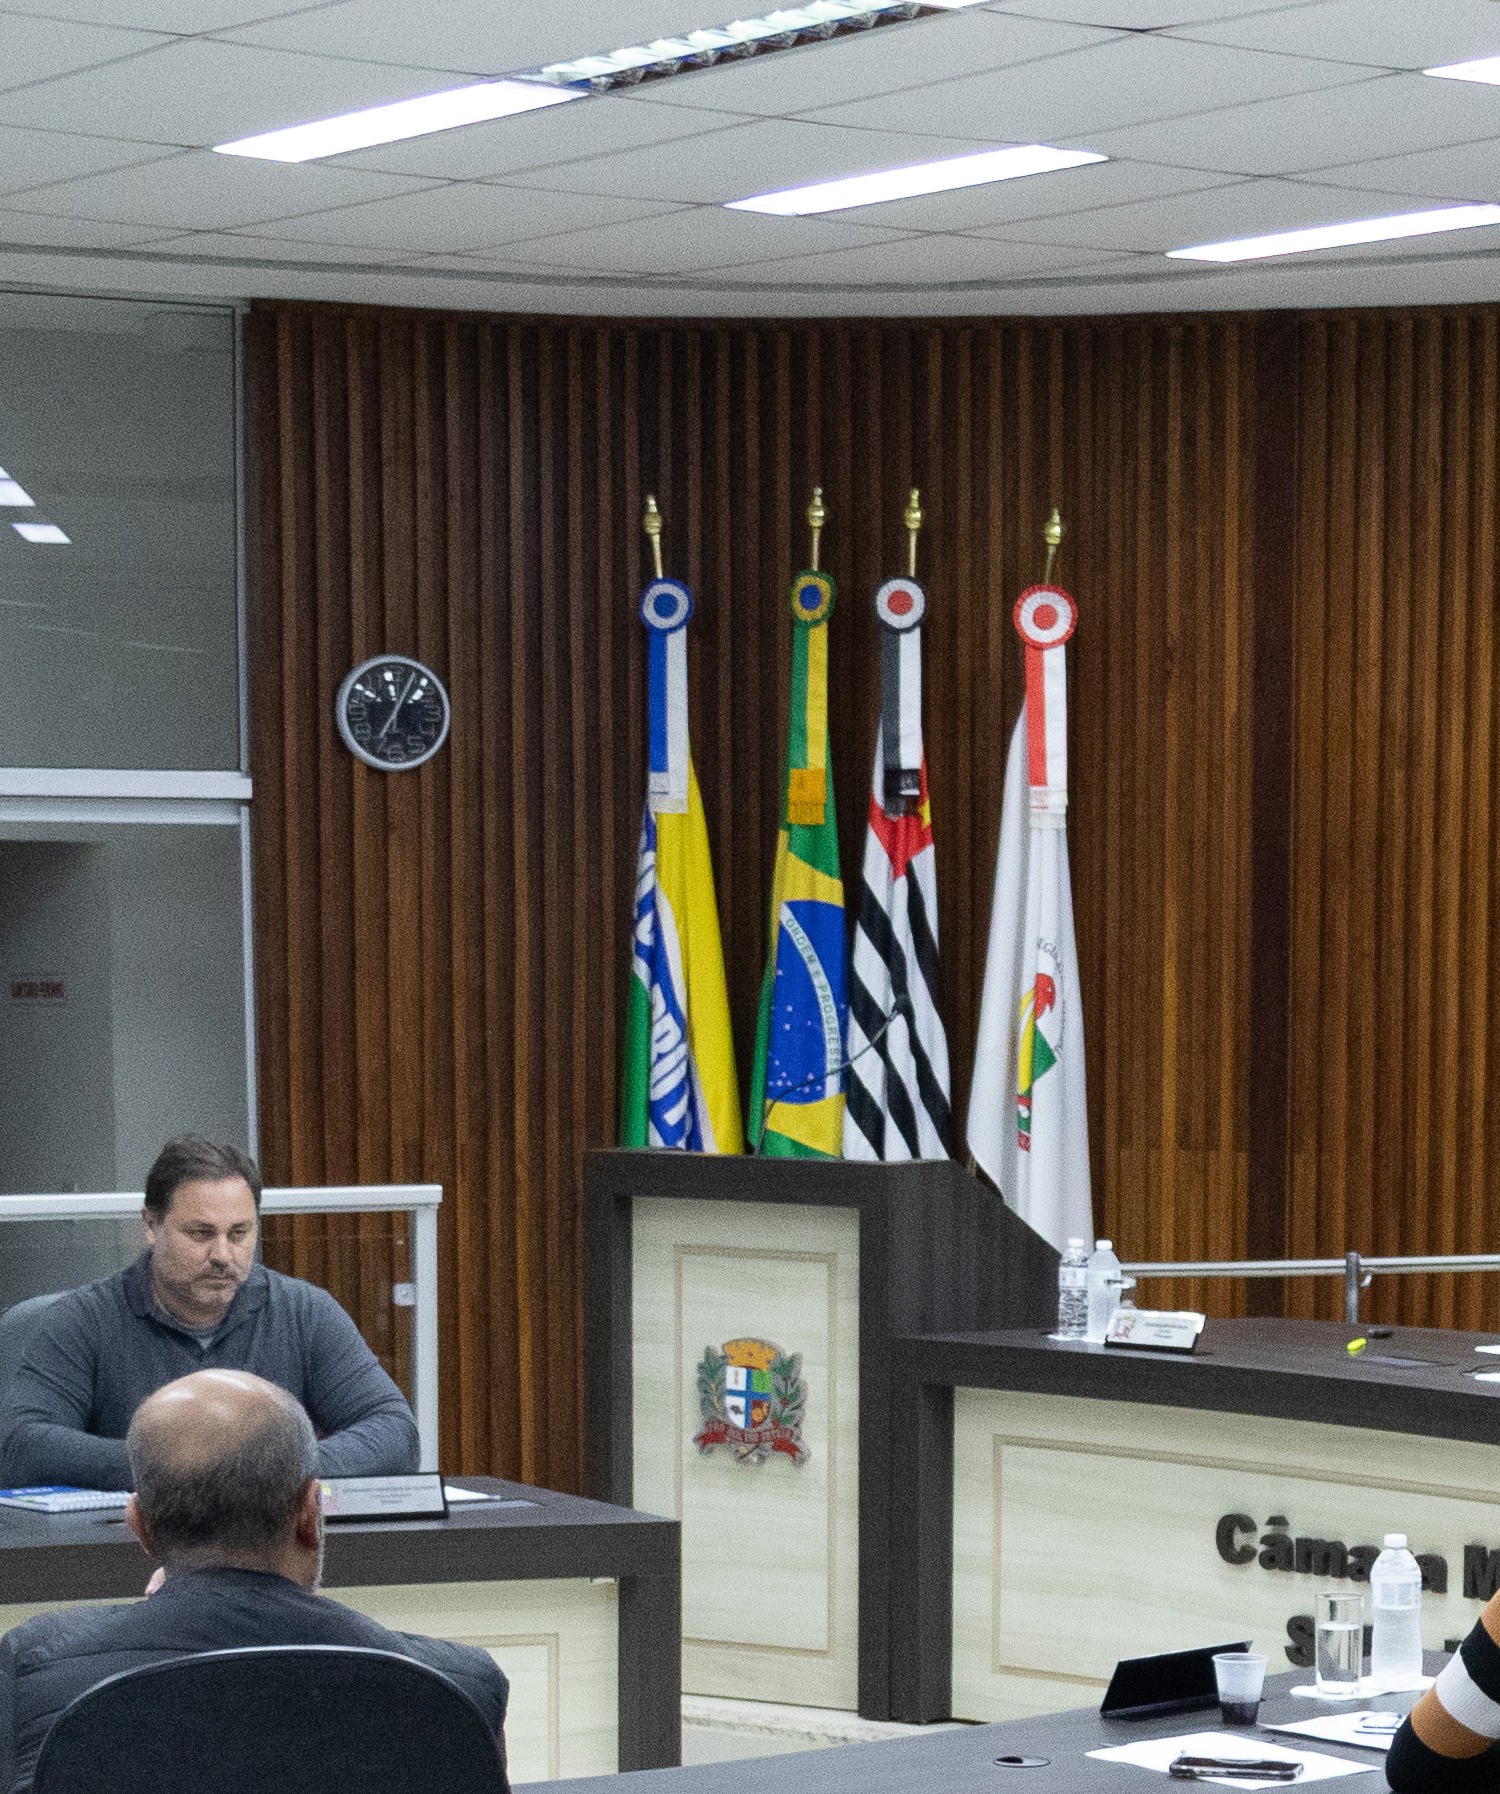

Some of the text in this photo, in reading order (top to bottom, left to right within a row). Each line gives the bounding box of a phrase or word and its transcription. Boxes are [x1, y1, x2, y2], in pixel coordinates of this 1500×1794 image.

[785, 917, 817, 966] ORDEM
[818, 983, 841, 1072] PROGRESS
[1215, 1513, 1449, 1594] Câmaa
